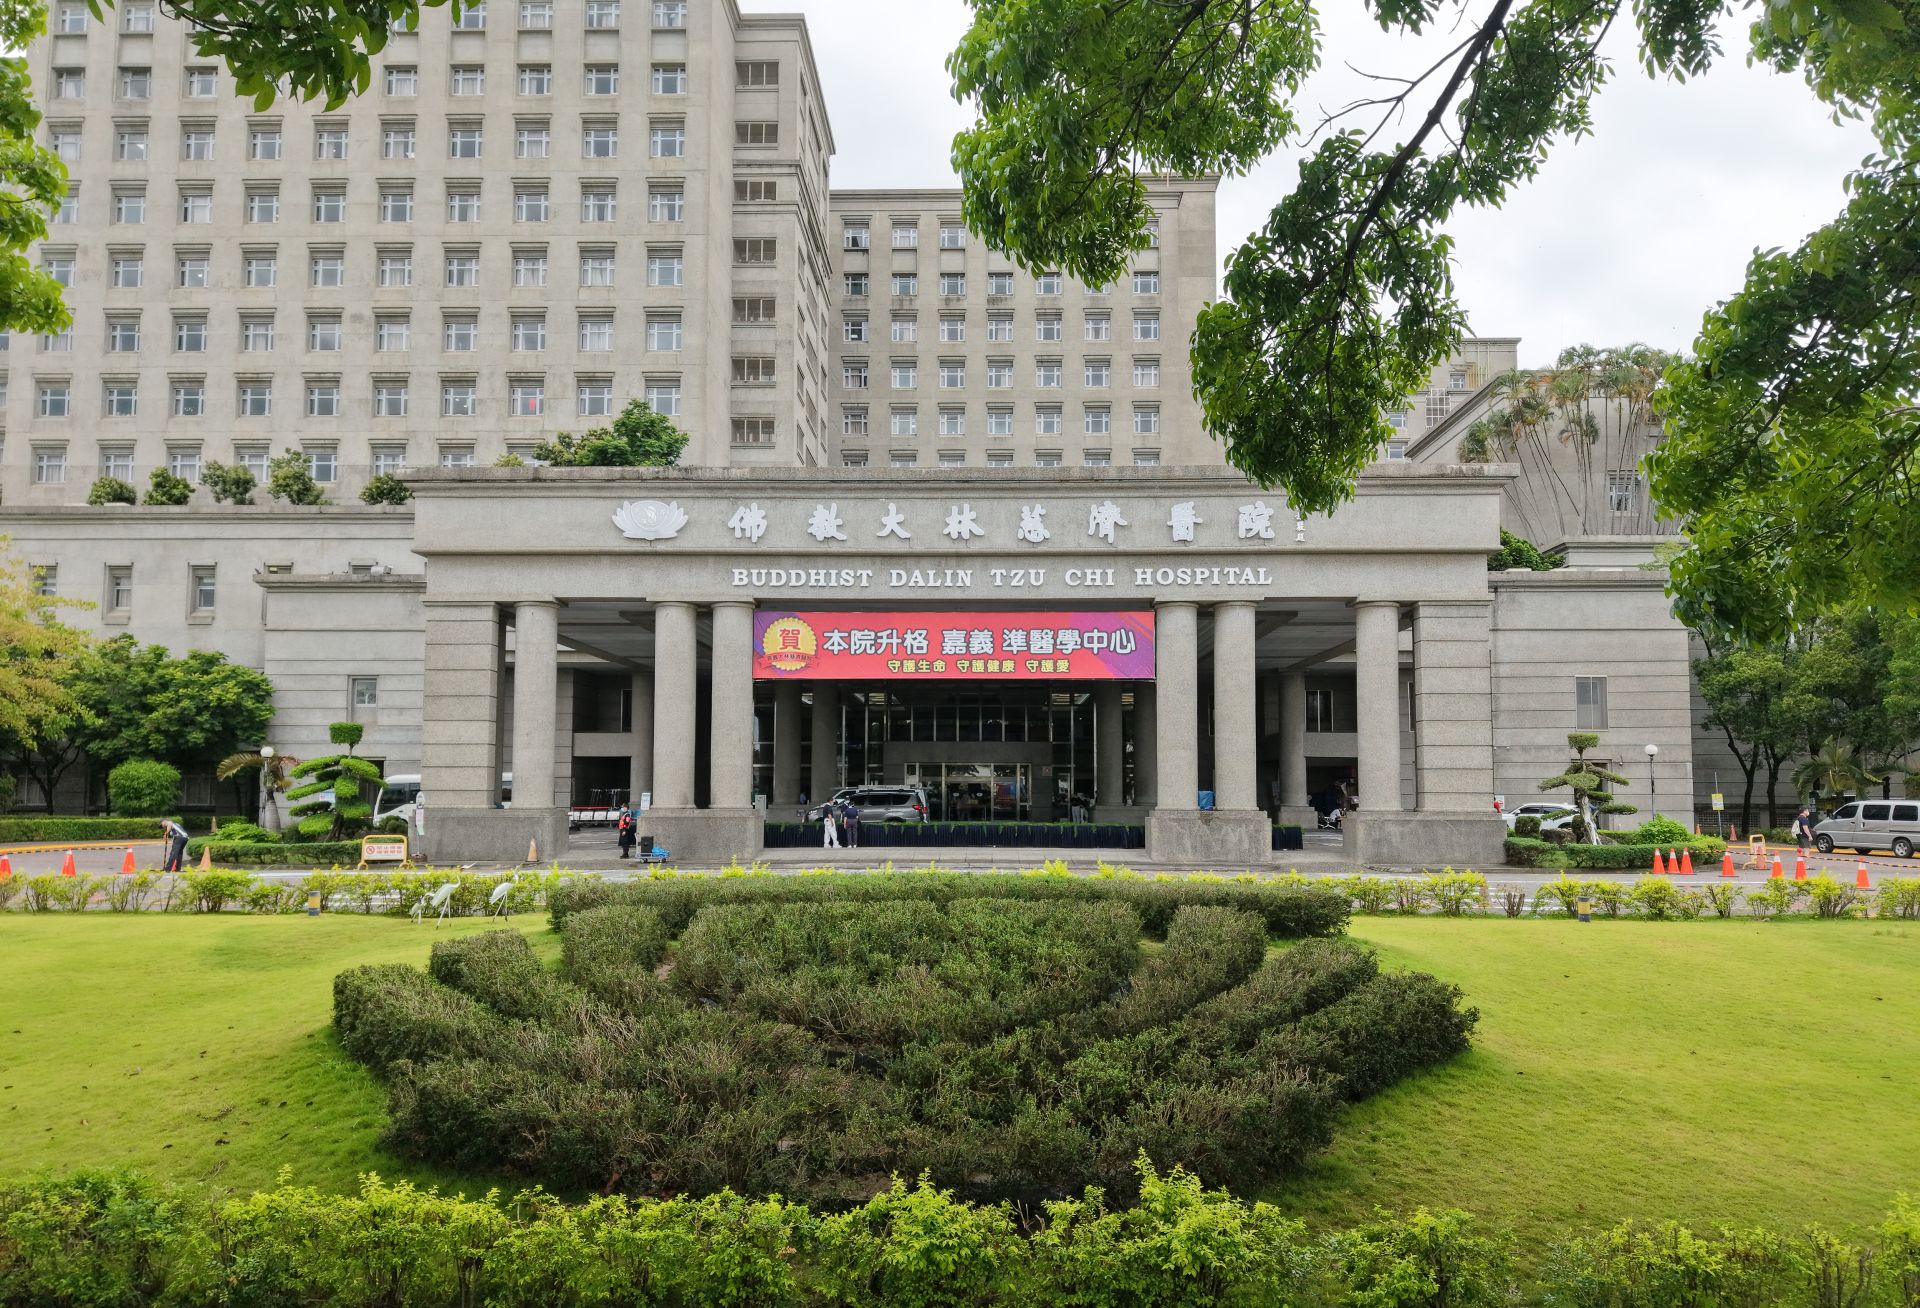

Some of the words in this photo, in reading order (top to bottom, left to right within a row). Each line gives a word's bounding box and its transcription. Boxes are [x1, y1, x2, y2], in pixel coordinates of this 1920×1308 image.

[732, 568, 873, 588] BUDDHIST
[889, 568, 974, 587] DALIN
[990, 568, 1046, 587] TZU
[1064, 568, 1115, 587] CHI
[1134, 567, 1273, 586] HOSPITAL
[778, 628, 801, 650] 賀
[822, 628, 928, 655] 本院升格
[941, 628, 994, 655] 嘉義
[1001, 628, 1136, 655] 準醫學中心
[887, 659, 946, 673] 守護生命
[956, 659, 1016, 673] 守護健康
[1026, 659, 1071, 673] 守護愛
